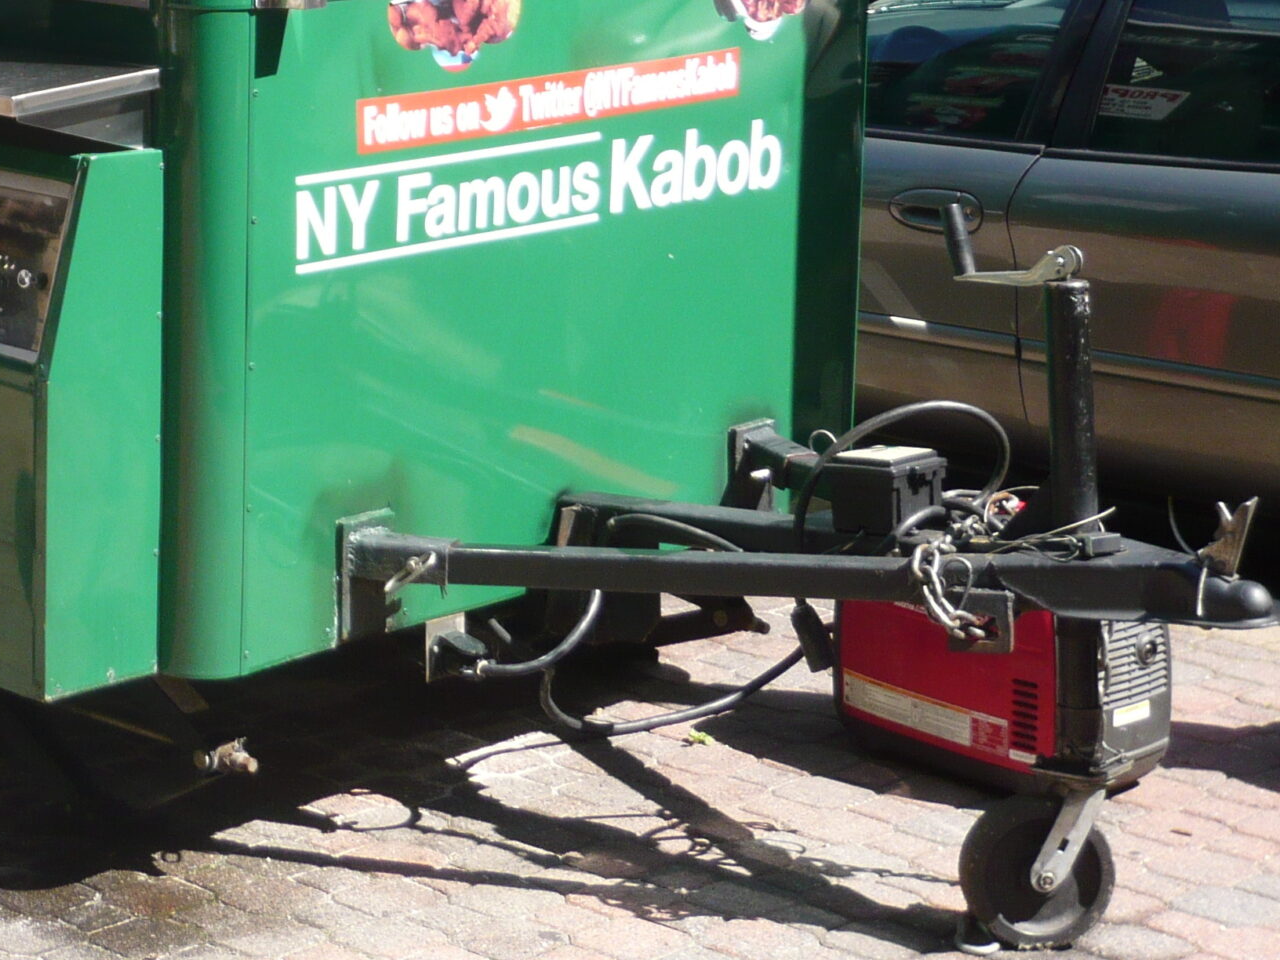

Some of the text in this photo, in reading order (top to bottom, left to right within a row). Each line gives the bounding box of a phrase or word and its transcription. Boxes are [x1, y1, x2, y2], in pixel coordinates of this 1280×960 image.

[363, 56, 737, 146] Follow us on Twitter @NYFamousKabob
[296, 118, 783, 260] NY Famous Kabob
